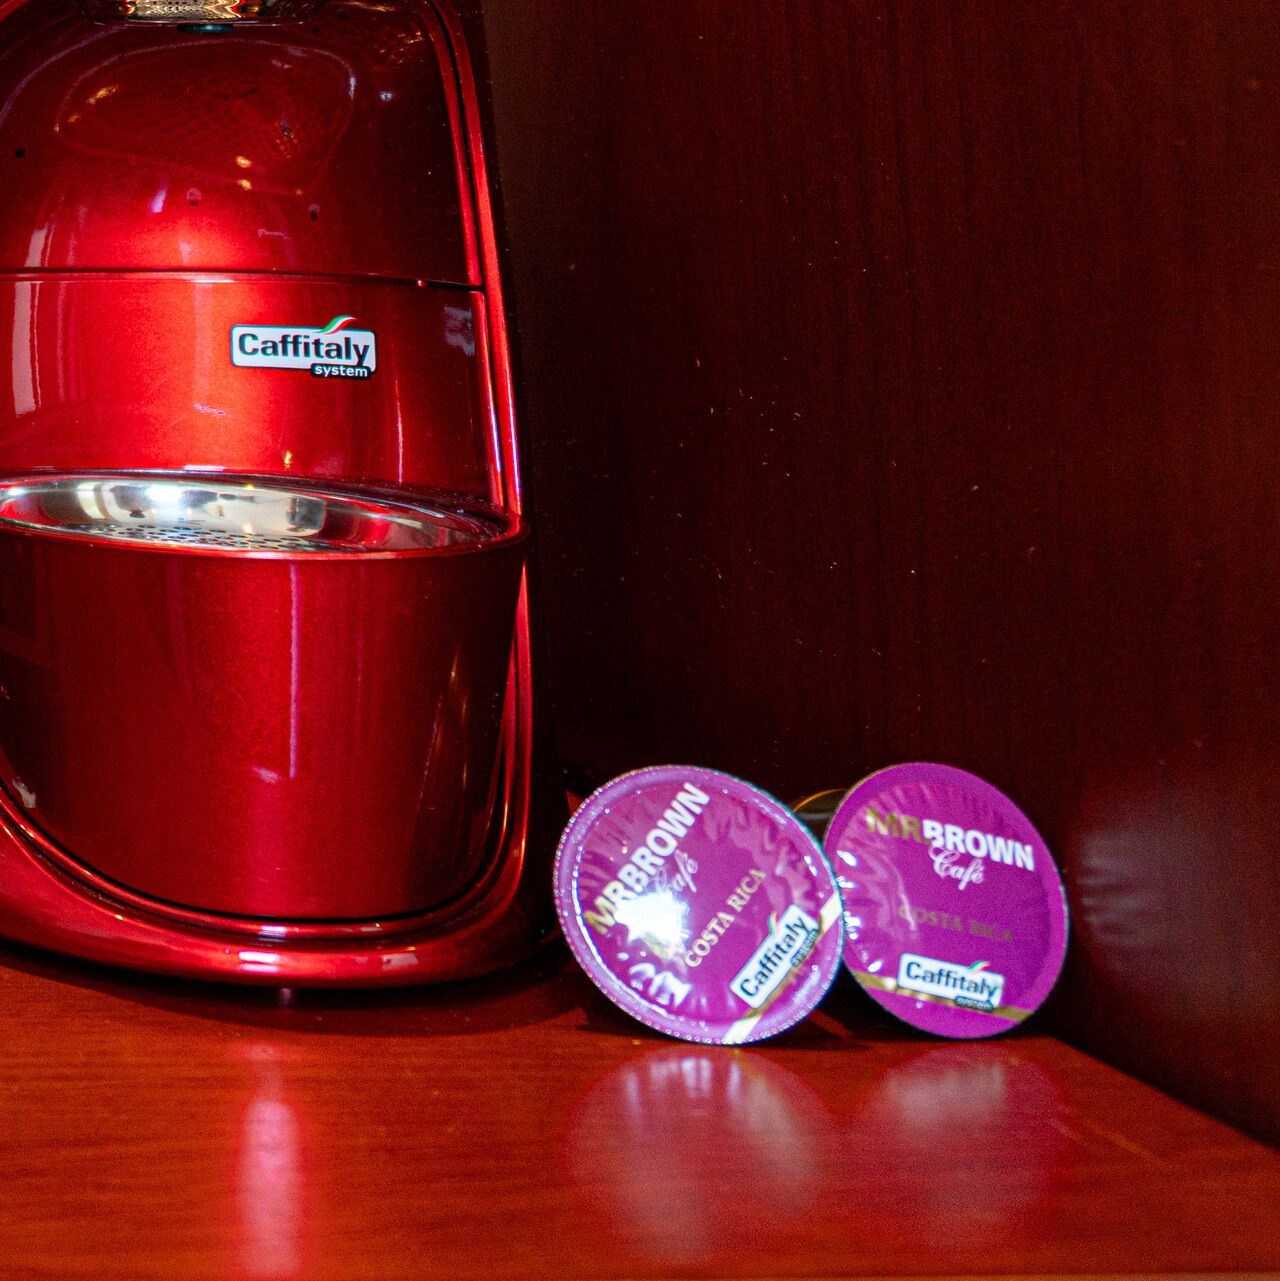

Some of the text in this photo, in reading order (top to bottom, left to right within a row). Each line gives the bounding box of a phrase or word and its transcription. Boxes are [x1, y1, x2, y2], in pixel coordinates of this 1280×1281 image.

[238, 333, 370, 366] Caffitaly
[314, 365, 368, 378] system
[684, 868, 767, 967] COSTA RICA
[740, 917, 810, 996] Caffitaly
[906, 961, 998, 1003] Caffitaly
